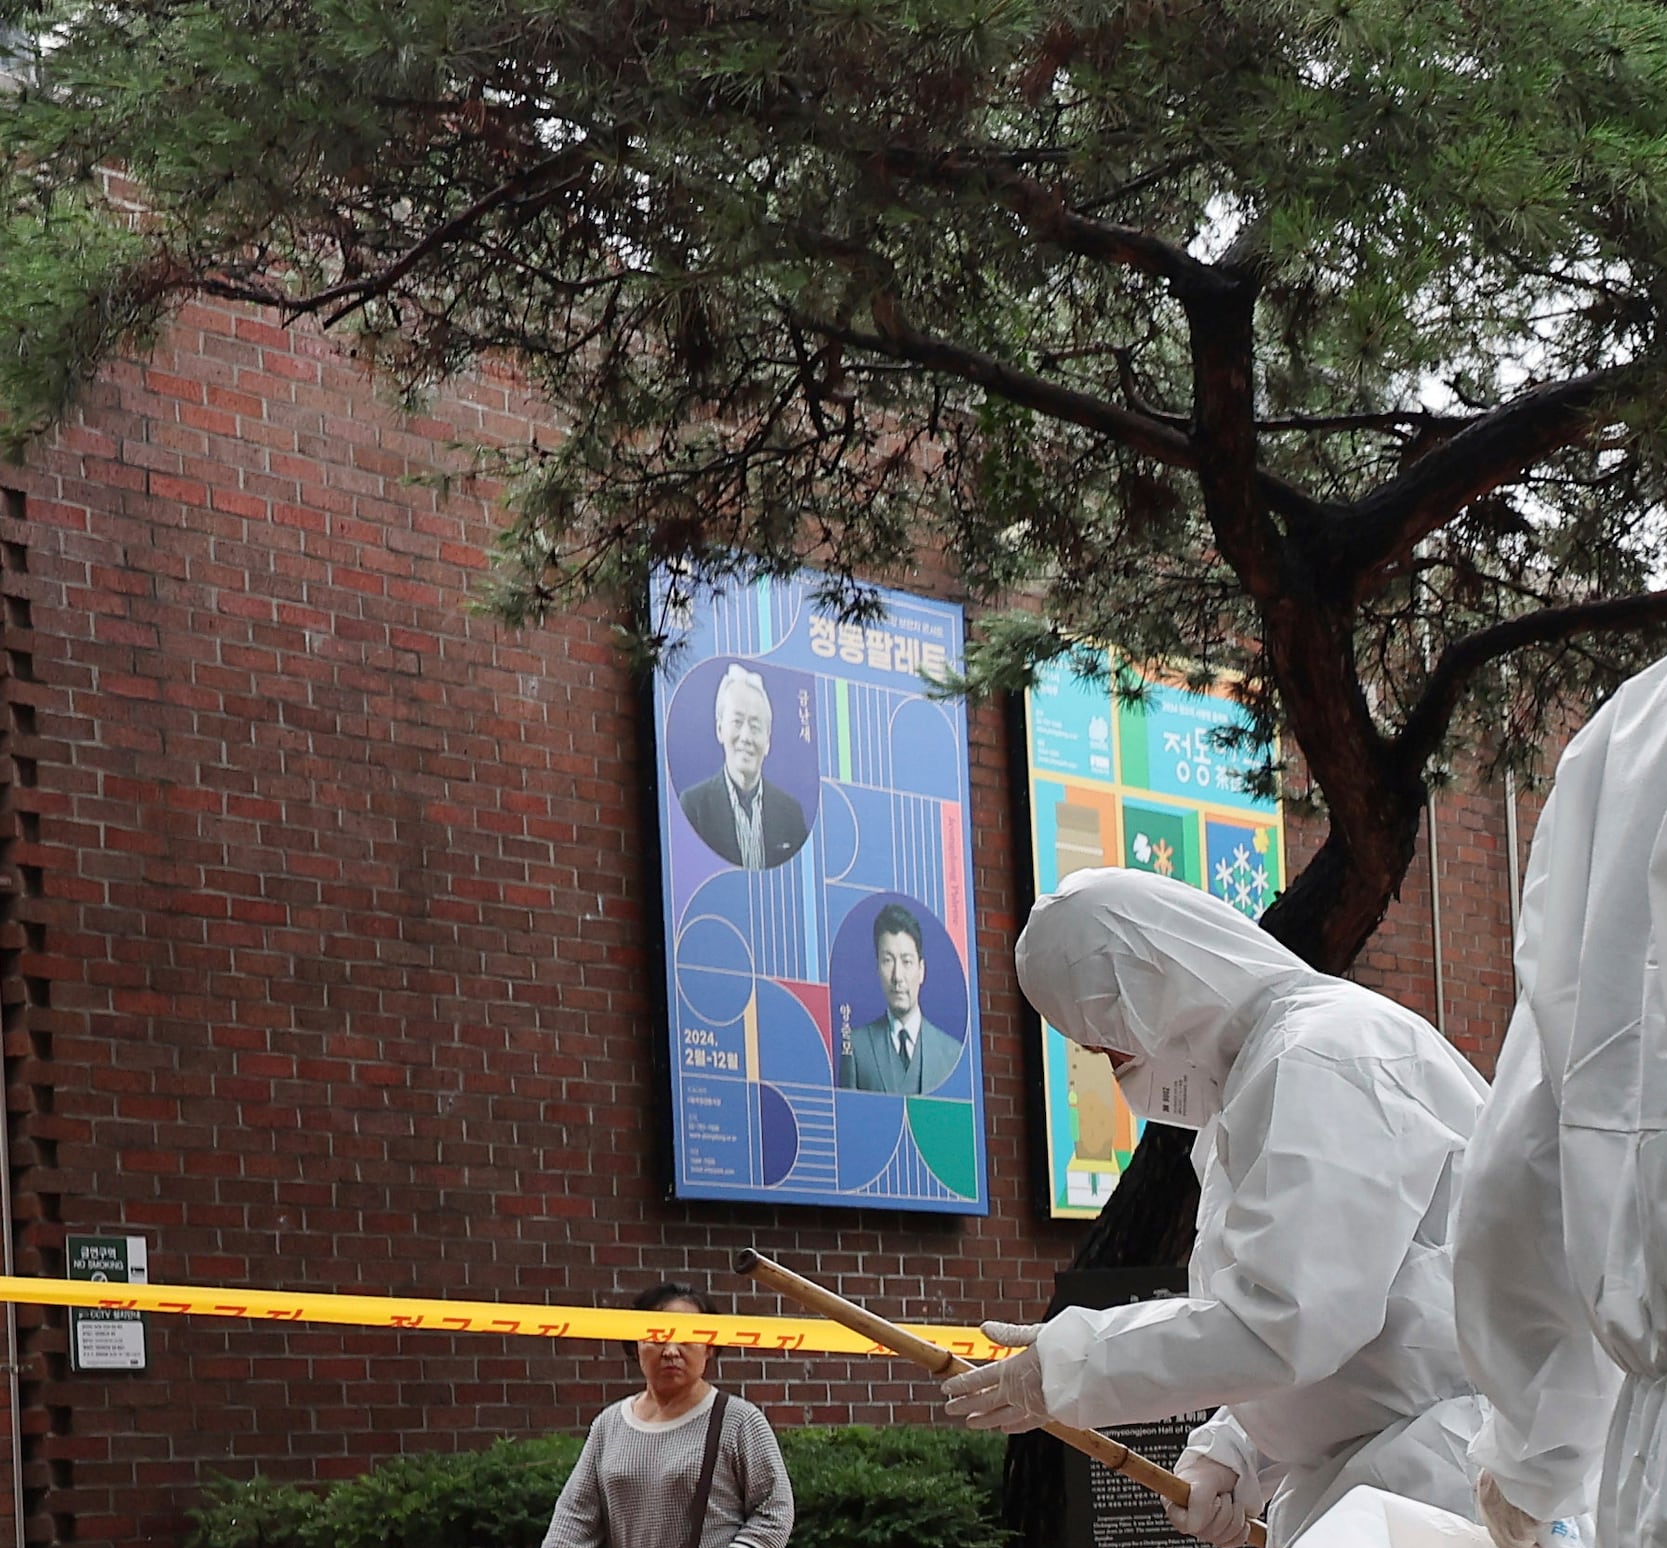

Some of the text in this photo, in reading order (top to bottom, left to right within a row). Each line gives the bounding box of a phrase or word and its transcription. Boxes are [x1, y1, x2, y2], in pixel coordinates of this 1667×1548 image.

[808, 614, 947, 683] 정동팔레트
[684, 1028, 718, 1048] 2024.
[685, 1048, 739, 1071] 2월-12월
[73, 1259, 124, 1271] NO SMOKING
